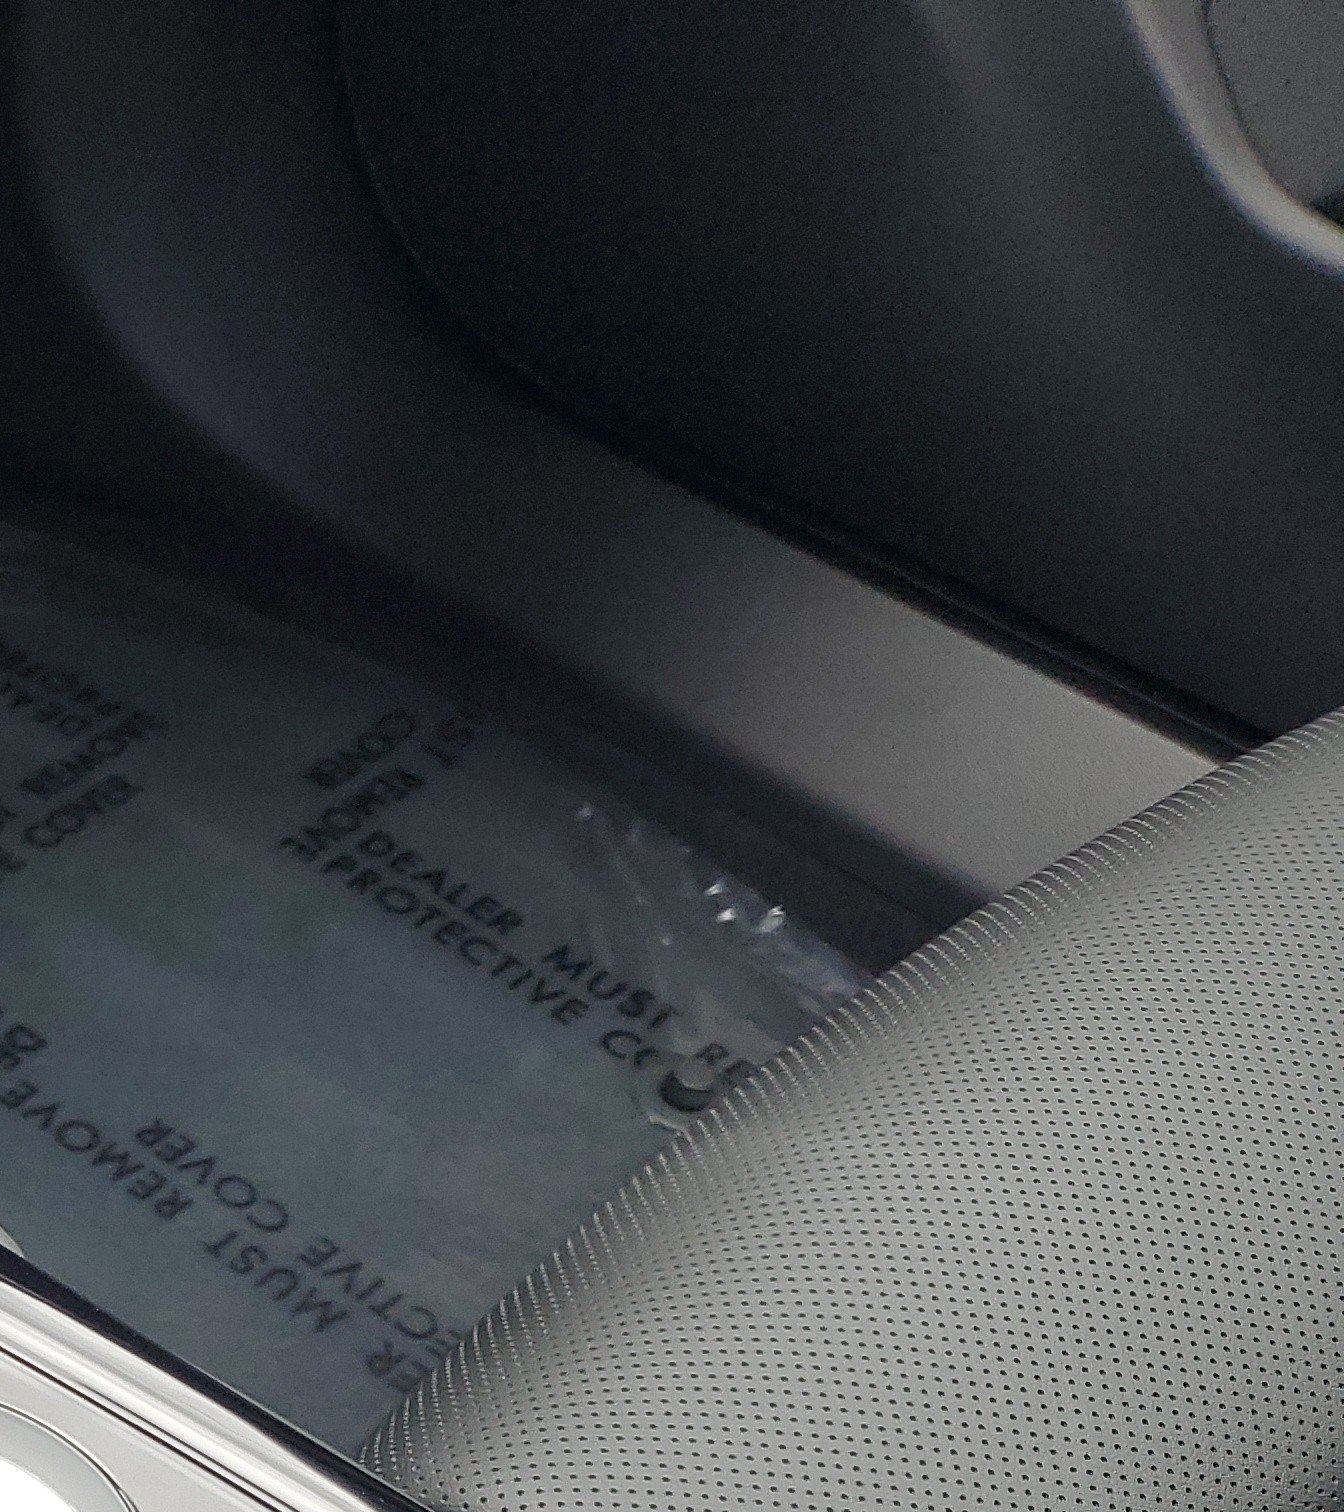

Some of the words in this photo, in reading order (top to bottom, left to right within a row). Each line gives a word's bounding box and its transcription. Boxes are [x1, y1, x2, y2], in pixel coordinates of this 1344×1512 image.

[321, 854, 590, 1026] PROTECTIVE
[357, 829, 524, 936] DEALER
[541, 944, 682, 1031] MUST
[133, 1116, 292, 1234] COVER
[199, 1228, 351, 1335] MUST
